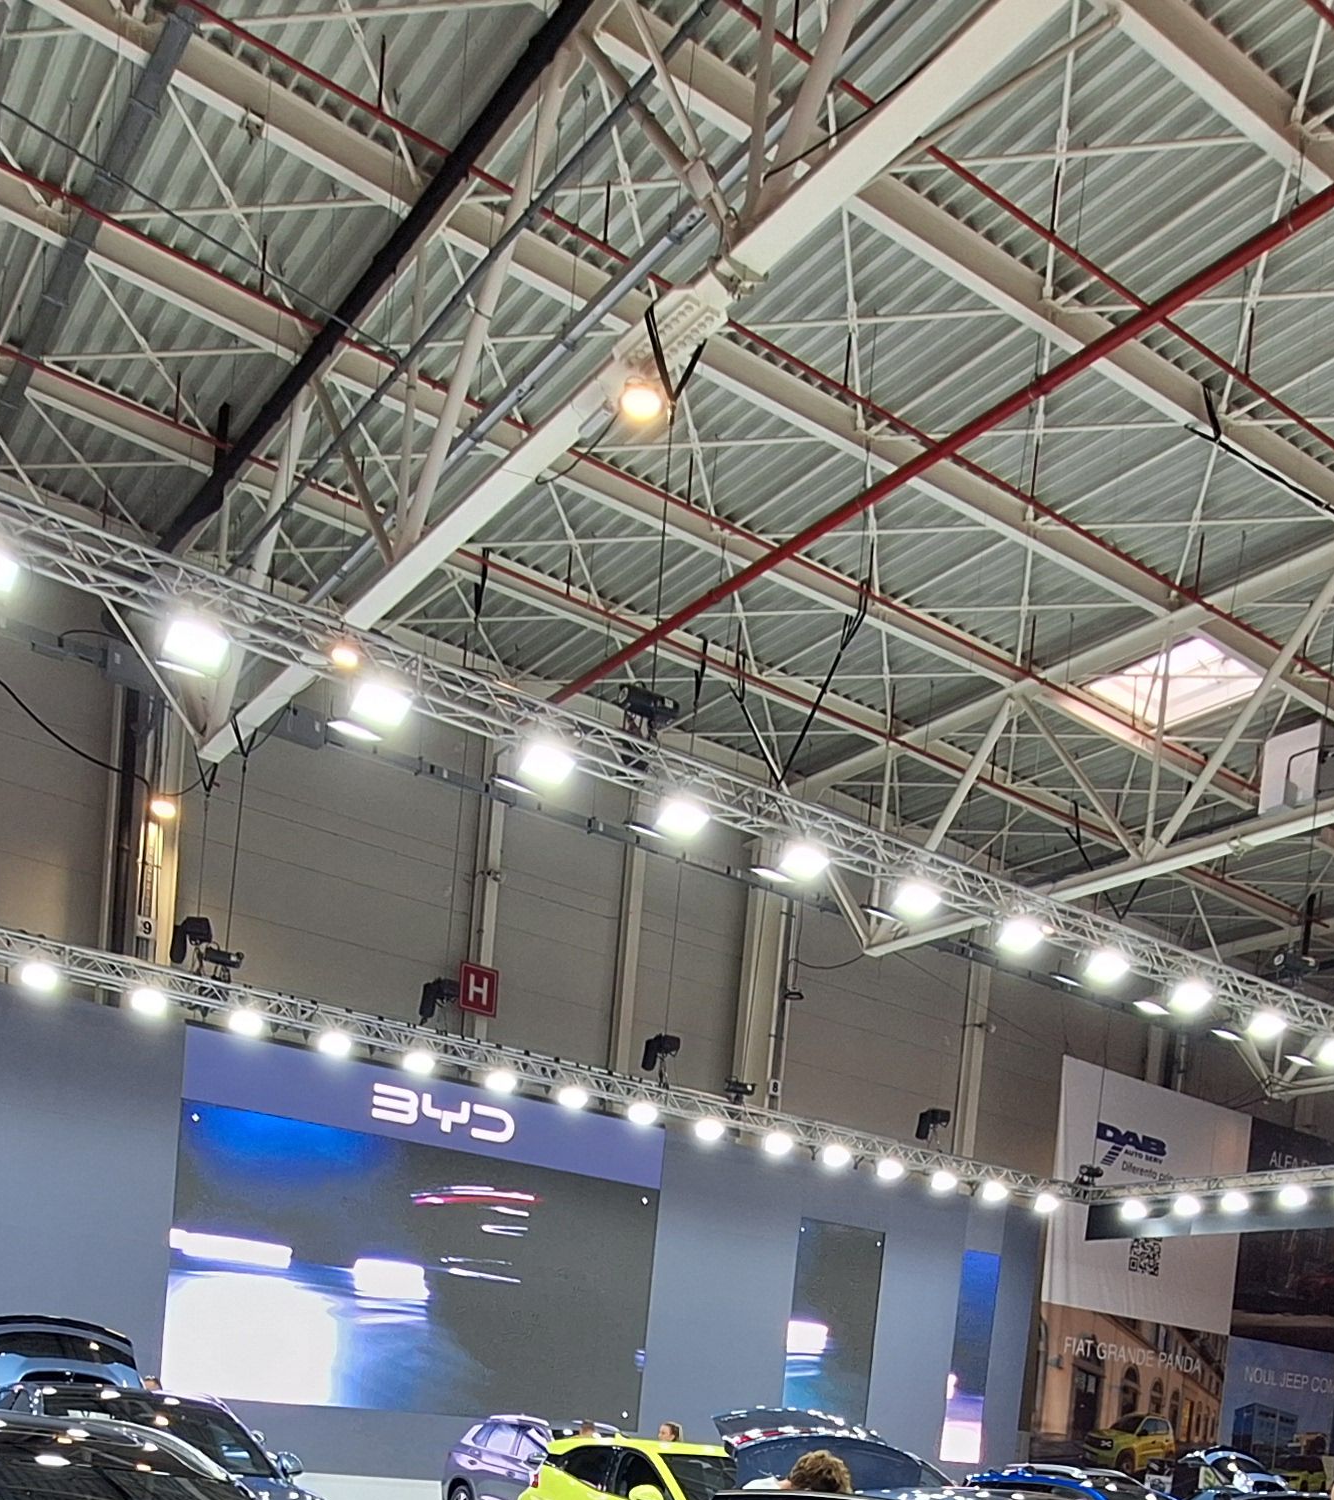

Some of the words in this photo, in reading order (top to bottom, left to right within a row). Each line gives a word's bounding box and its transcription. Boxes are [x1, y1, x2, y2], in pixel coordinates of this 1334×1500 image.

[468, 972, 489, 1006] H
[370, 1082, 516, 1143] BYD
[1096, 1121, 1167, 1157] DAB
[1124, 1148, 1144, 1160] AUTO
[1144, 1154, 1164, 1165] SERV
[1063, 1336, 1094, 1359] FIAT
[1096, 1341, 1155, 1368] GRANDE
[1157, 1350, 1203, 1375] PANDA
[1245, 1366, 1278, 1387] NOUL
[1279, 1372, 1309, 1390] JEEP
